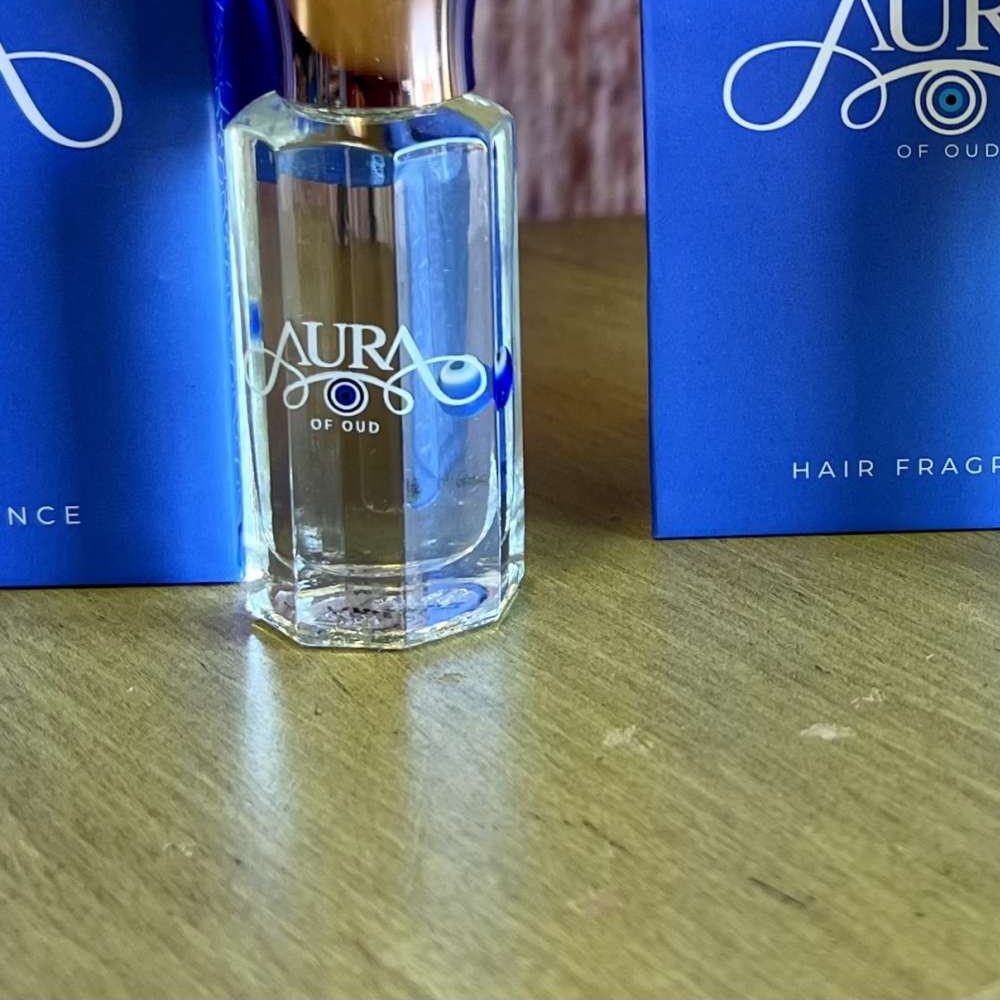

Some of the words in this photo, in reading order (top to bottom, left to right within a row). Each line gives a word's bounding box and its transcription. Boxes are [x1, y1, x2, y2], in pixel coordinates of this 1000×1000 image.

[896, 143, 929, 159] OF
[944, 143, 1000, 159] OUD
[310, 418, 334, 431] OF
[341, 419, 380, 434] OUD
[792, 459, 875, 480] HAIR
